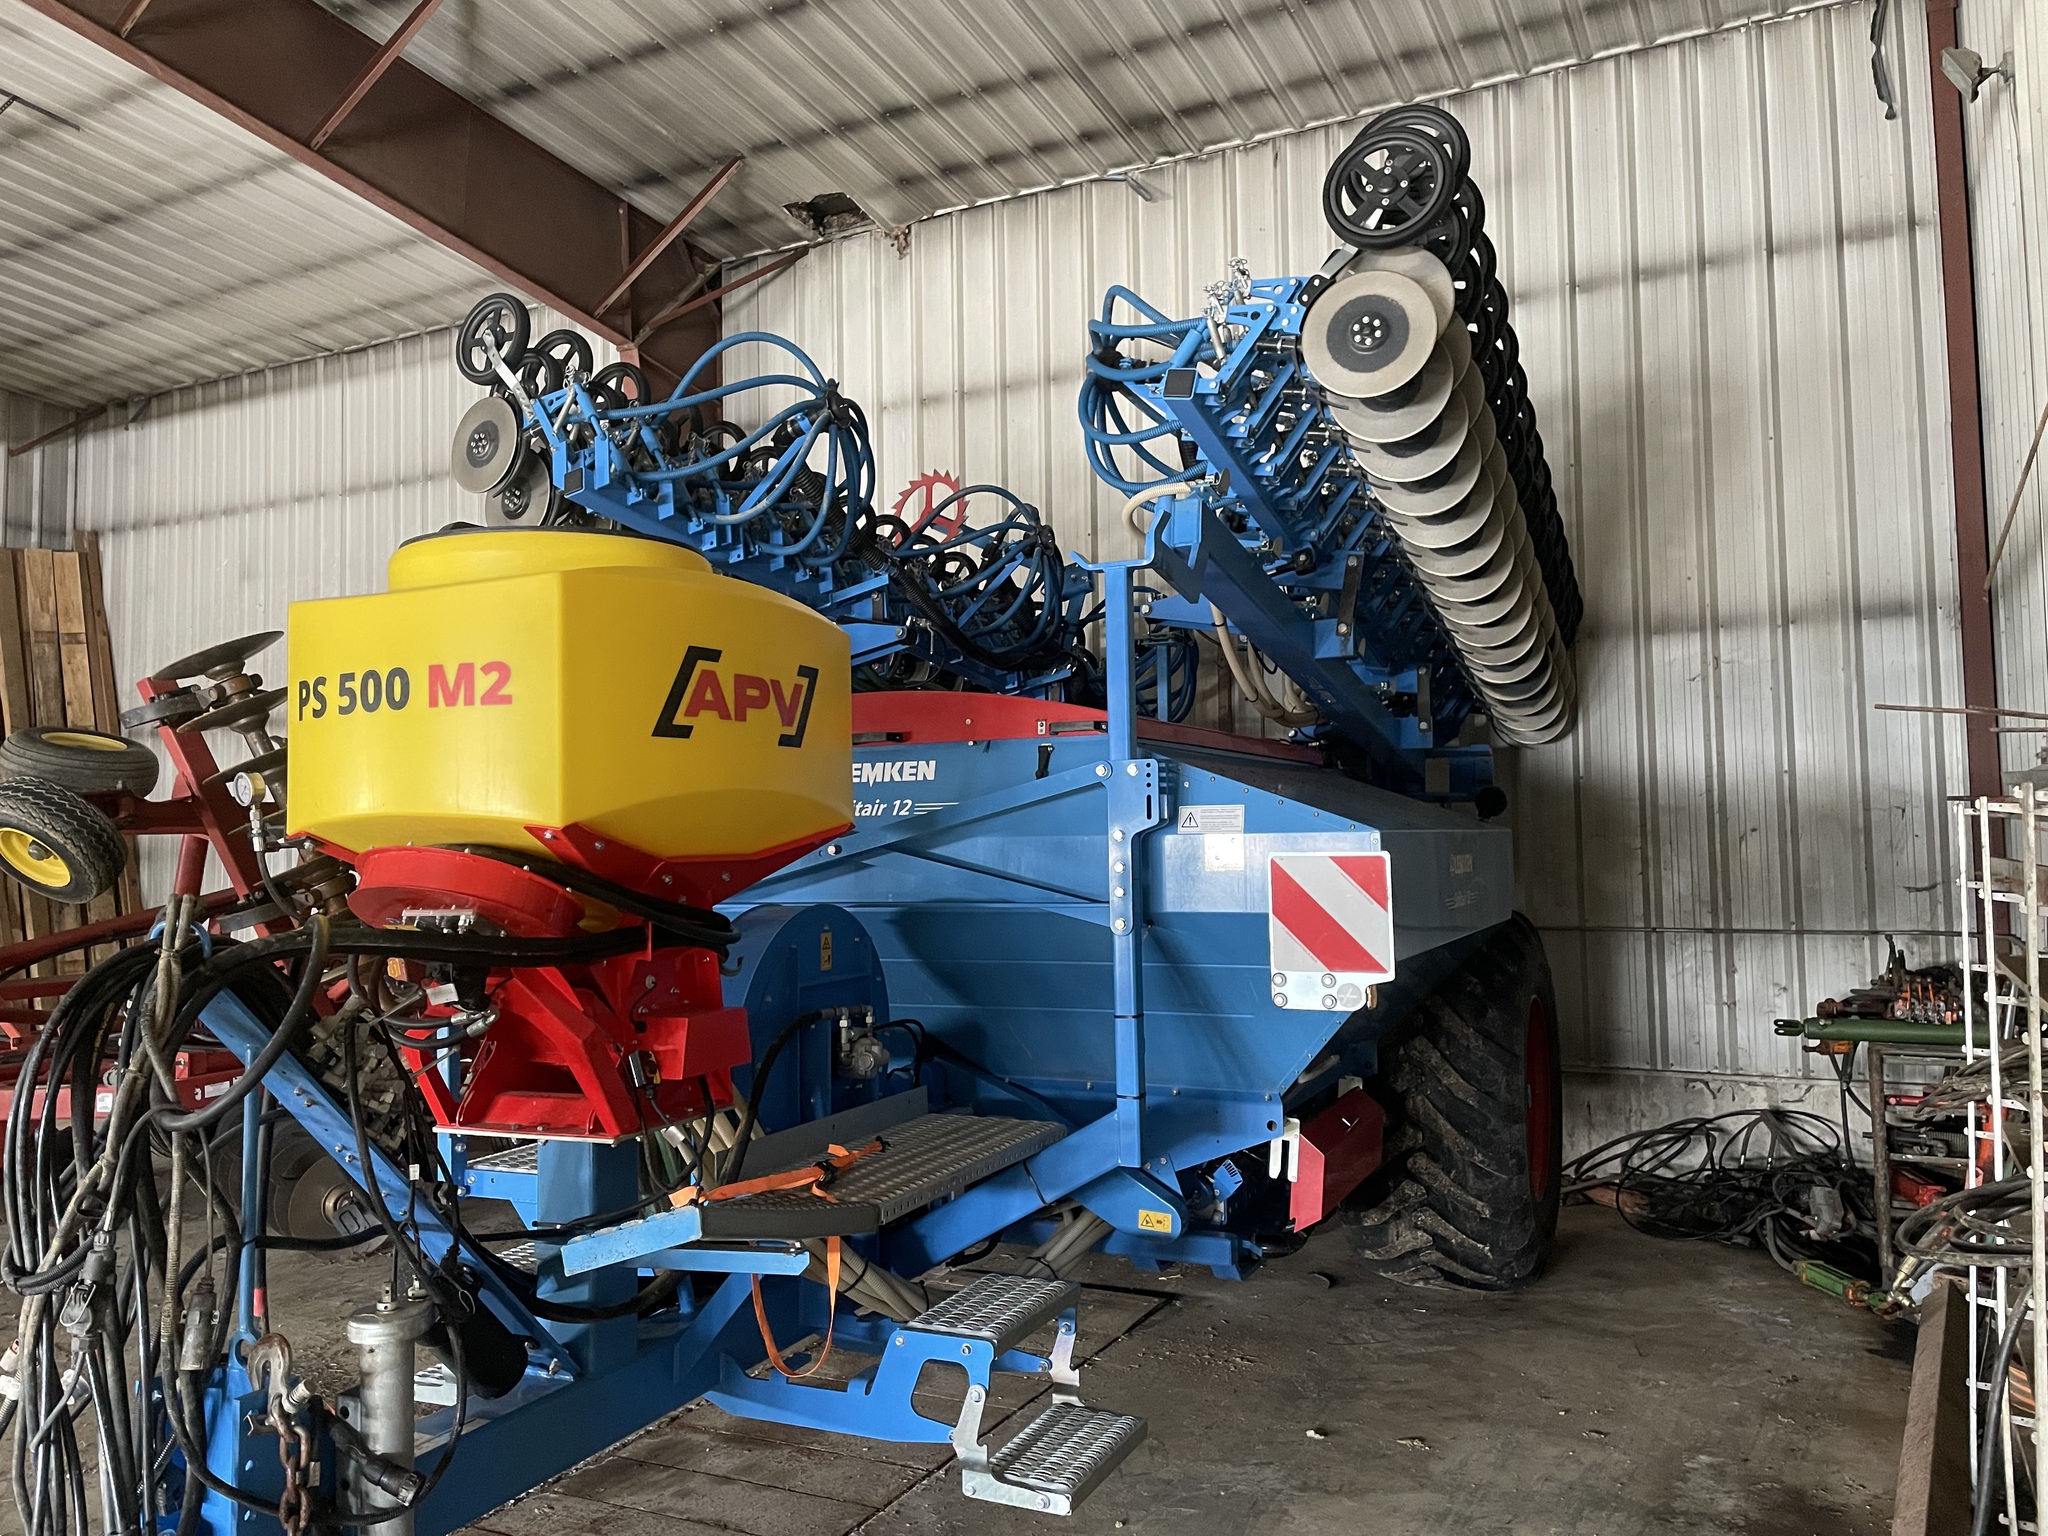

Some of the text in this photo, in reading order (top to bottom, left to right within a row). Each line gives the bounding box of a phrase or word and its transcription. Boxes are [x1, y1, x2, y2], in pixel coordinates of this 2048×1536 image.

[299, 661, 513, 721] PS 500 M2
[892, 799, 912, 815] 12
